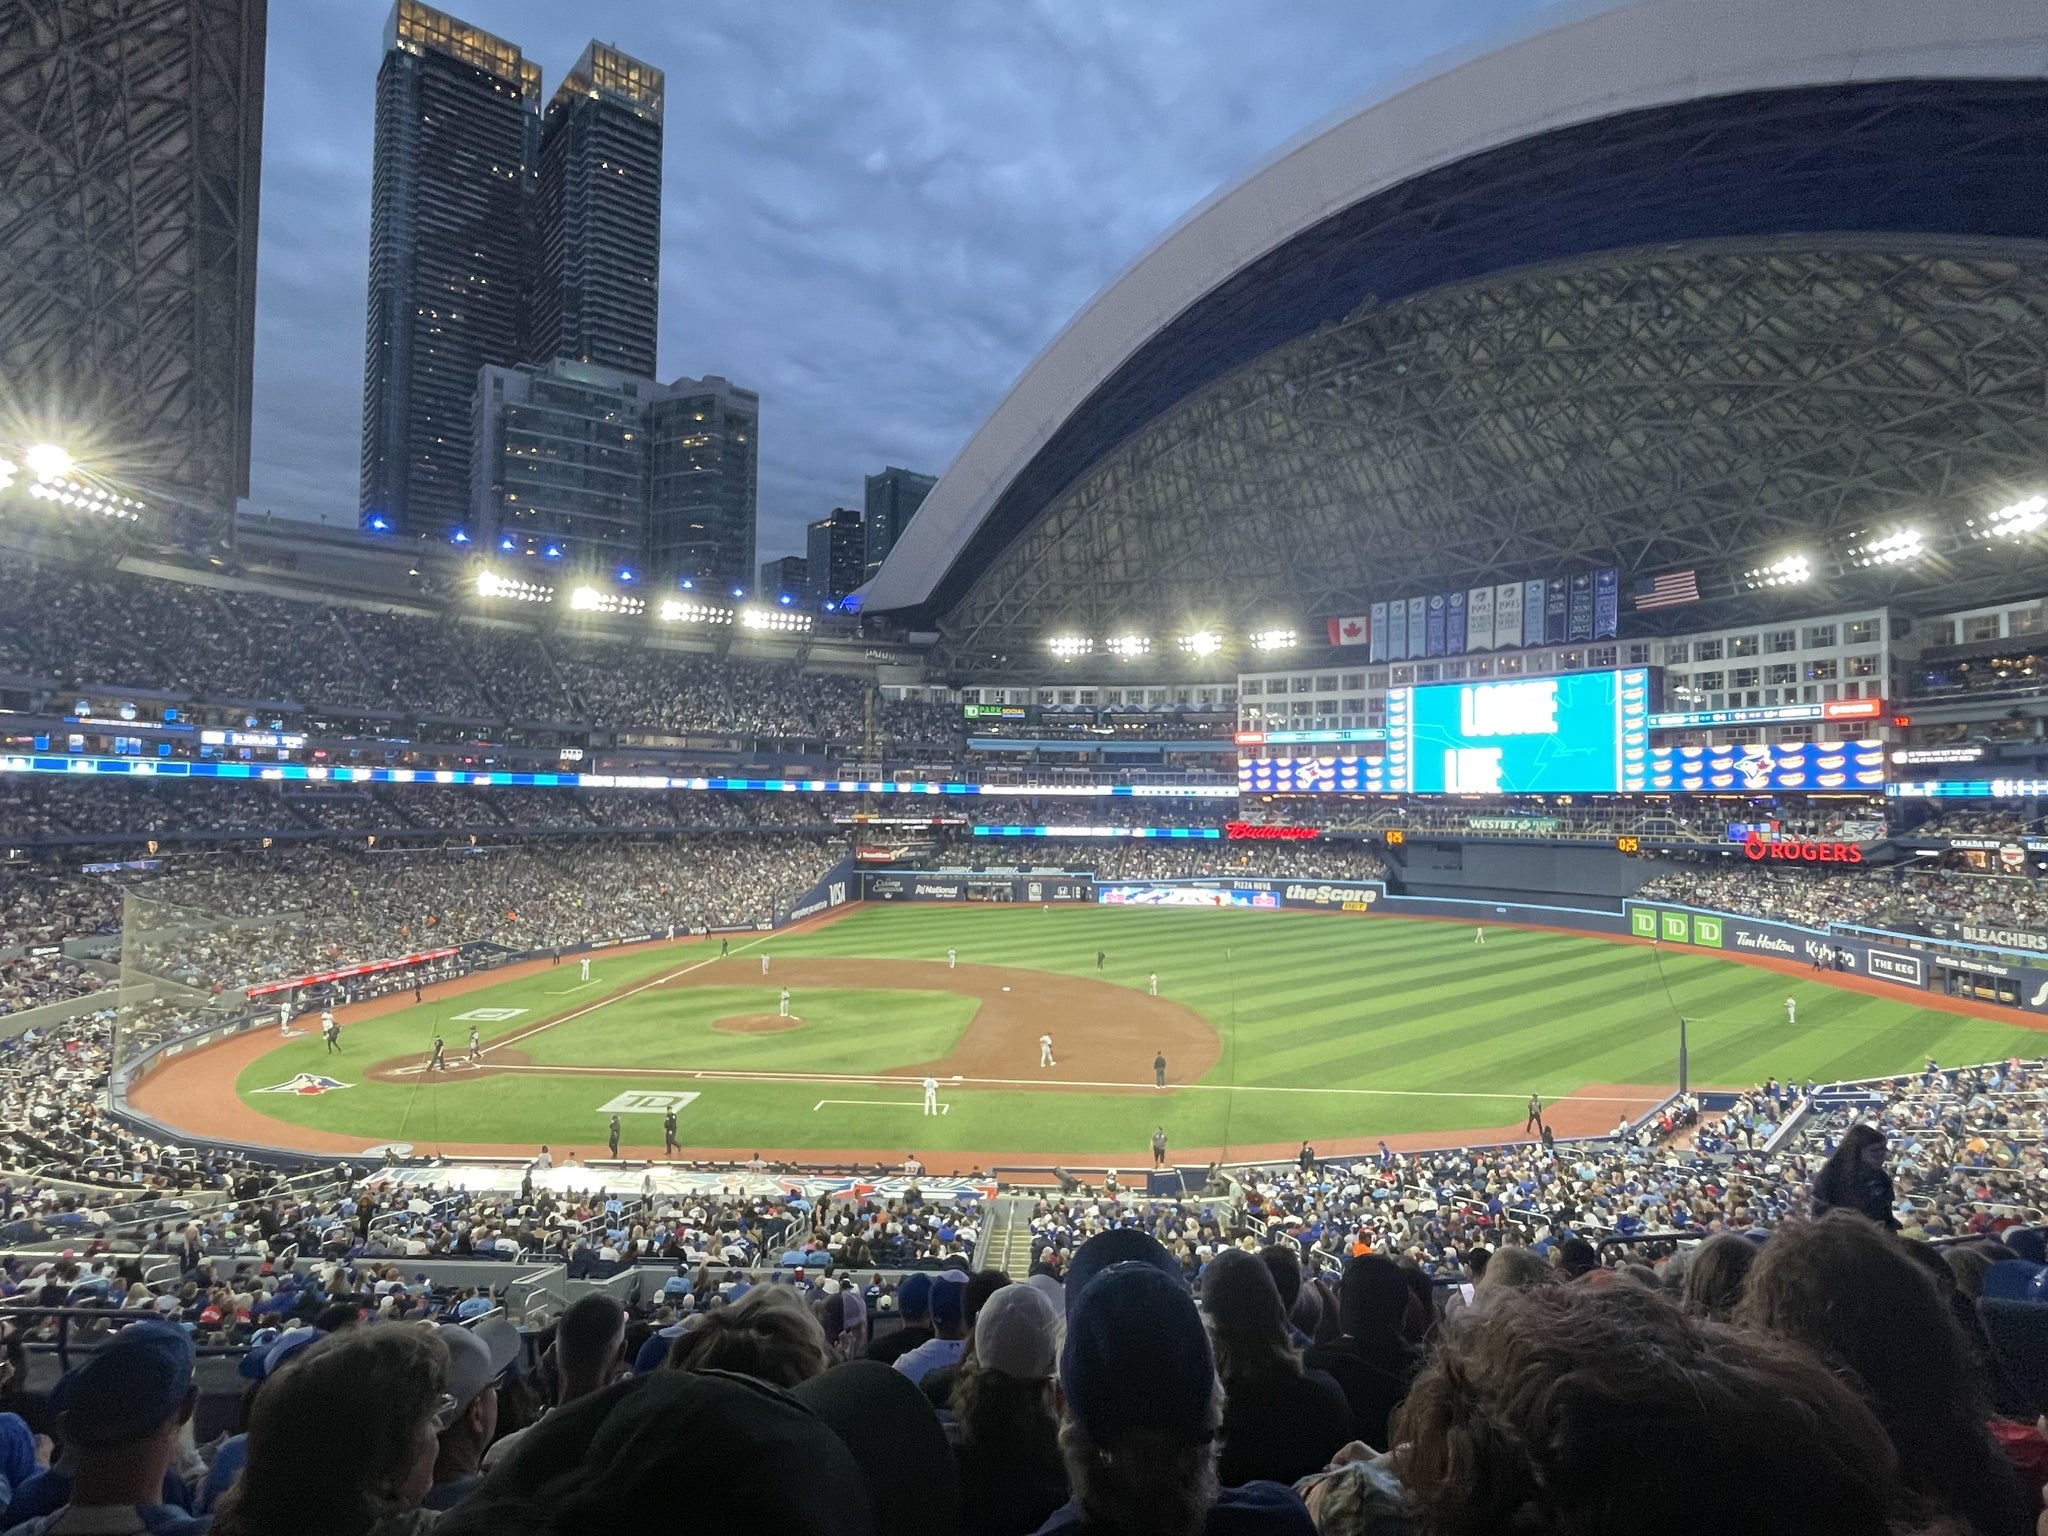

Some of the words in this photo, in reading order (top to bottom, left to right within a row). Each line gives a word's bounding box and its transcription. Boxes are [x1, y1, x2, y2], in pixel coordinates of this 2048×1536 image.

[1225, 822, 1318, 839] Budweiser
[1470, 819, 1517, 830] WESTJET
[1771, 842, 1862, 863] ROGERS
[1951, 840, 1982, 848] CANADA
[829, 882, 845, 906] VISA
[925, 886, 958, 894] National
[1234, 881, 1252, 889] PIZZA
[1254, 882, 1271, 891] NOVA
[1286, 885, 1377, 903] theScore
[690, 927, 706, 935] VISA
[1635, 914, 1655, 931] TD
[1665, 917, 1686, 936] TD
[1697, 921, 1719, 941] TD
[1736, 931, 1755, 947] Tim
[1756, 933, 1795, 953] Hortons
[1963, 926, 2047, 950] BLEACHERS
[1875, 959, 1893, 970] THE
[1895, 963, 1914, 975] KEG
